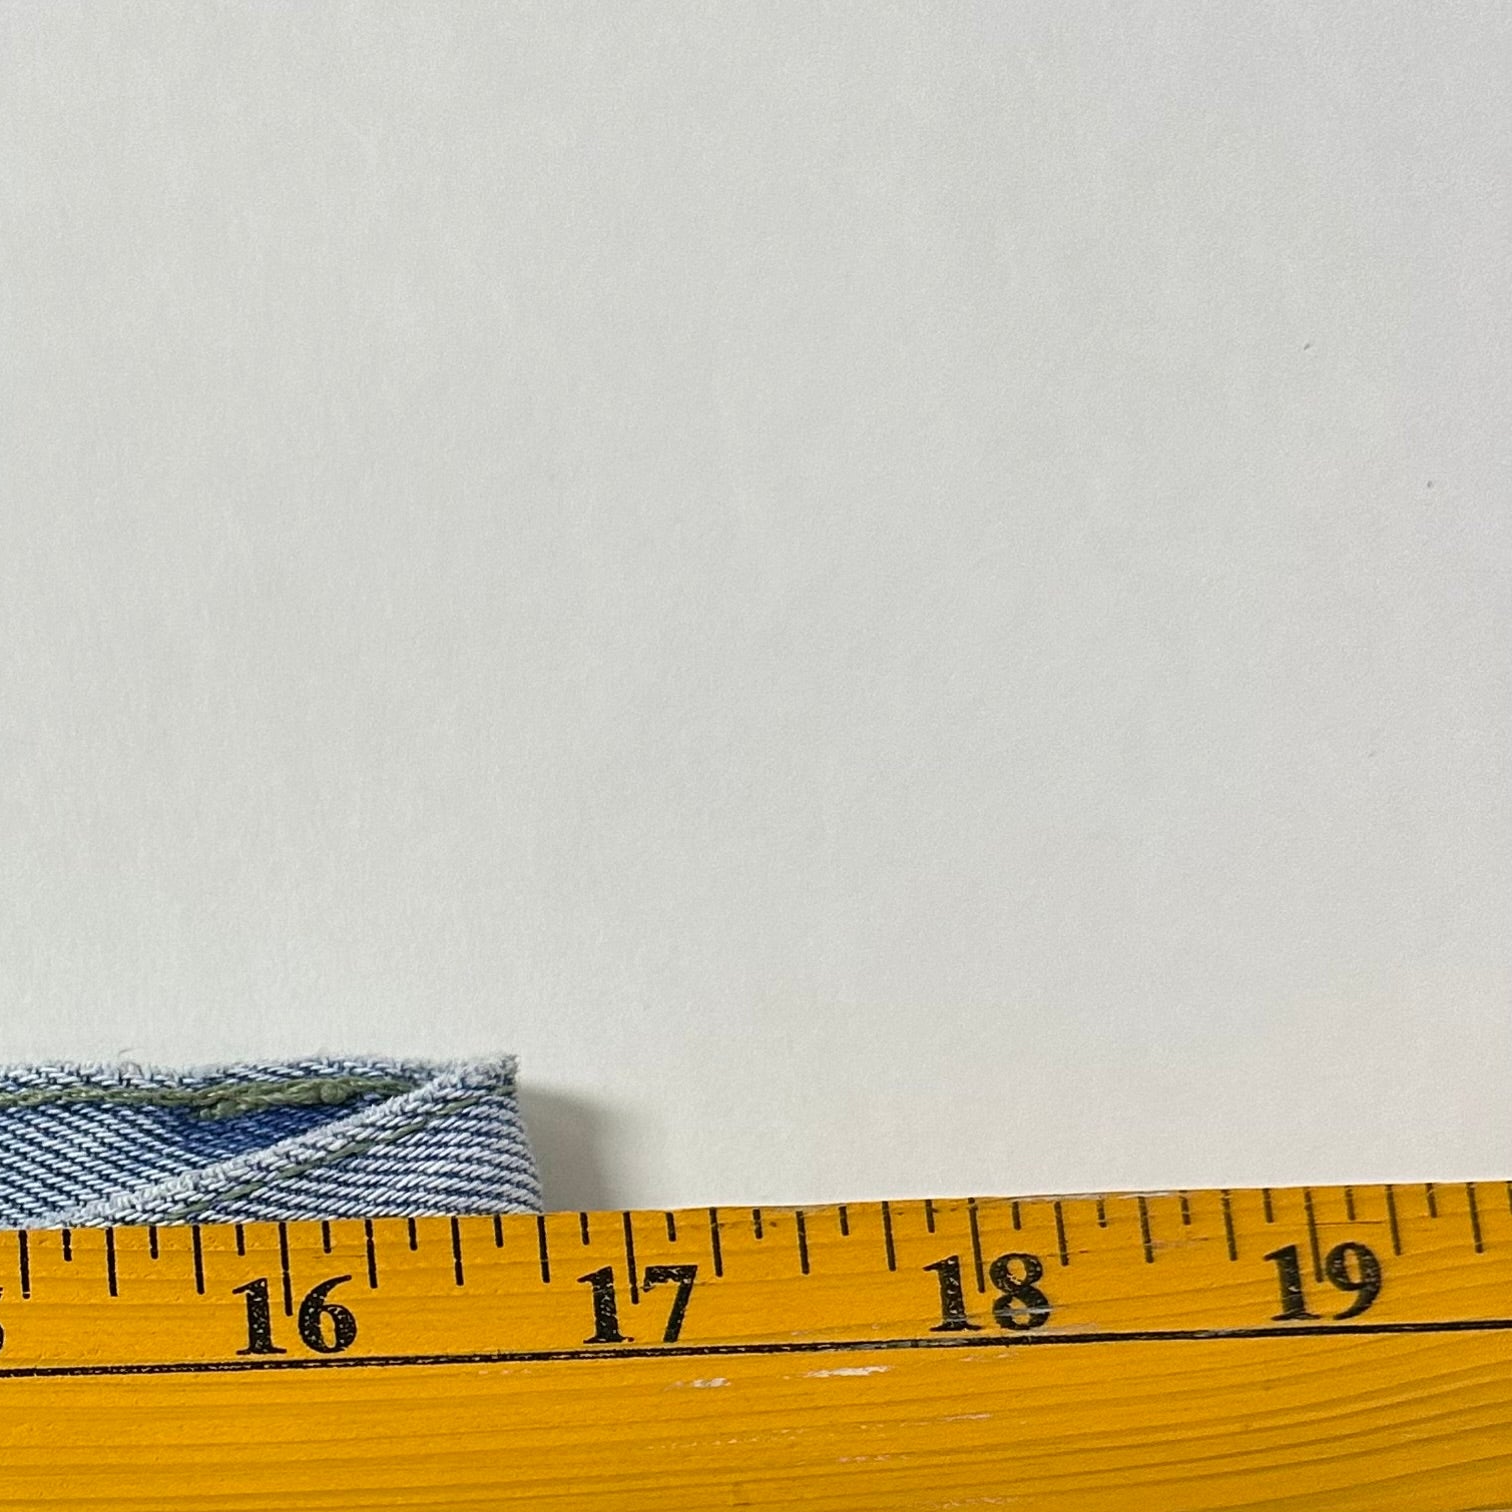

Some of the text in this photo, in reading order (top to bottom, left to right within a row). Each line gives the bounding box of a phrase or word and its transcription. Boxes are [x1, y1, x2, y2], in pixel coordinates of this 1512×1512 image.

[234, 1274, 358, 1356] 16
[576, 1264, 699, 1344] 17
[922, 1252, 1055, 1333] 18
[1263, 1240, 1383, 1322] 19
